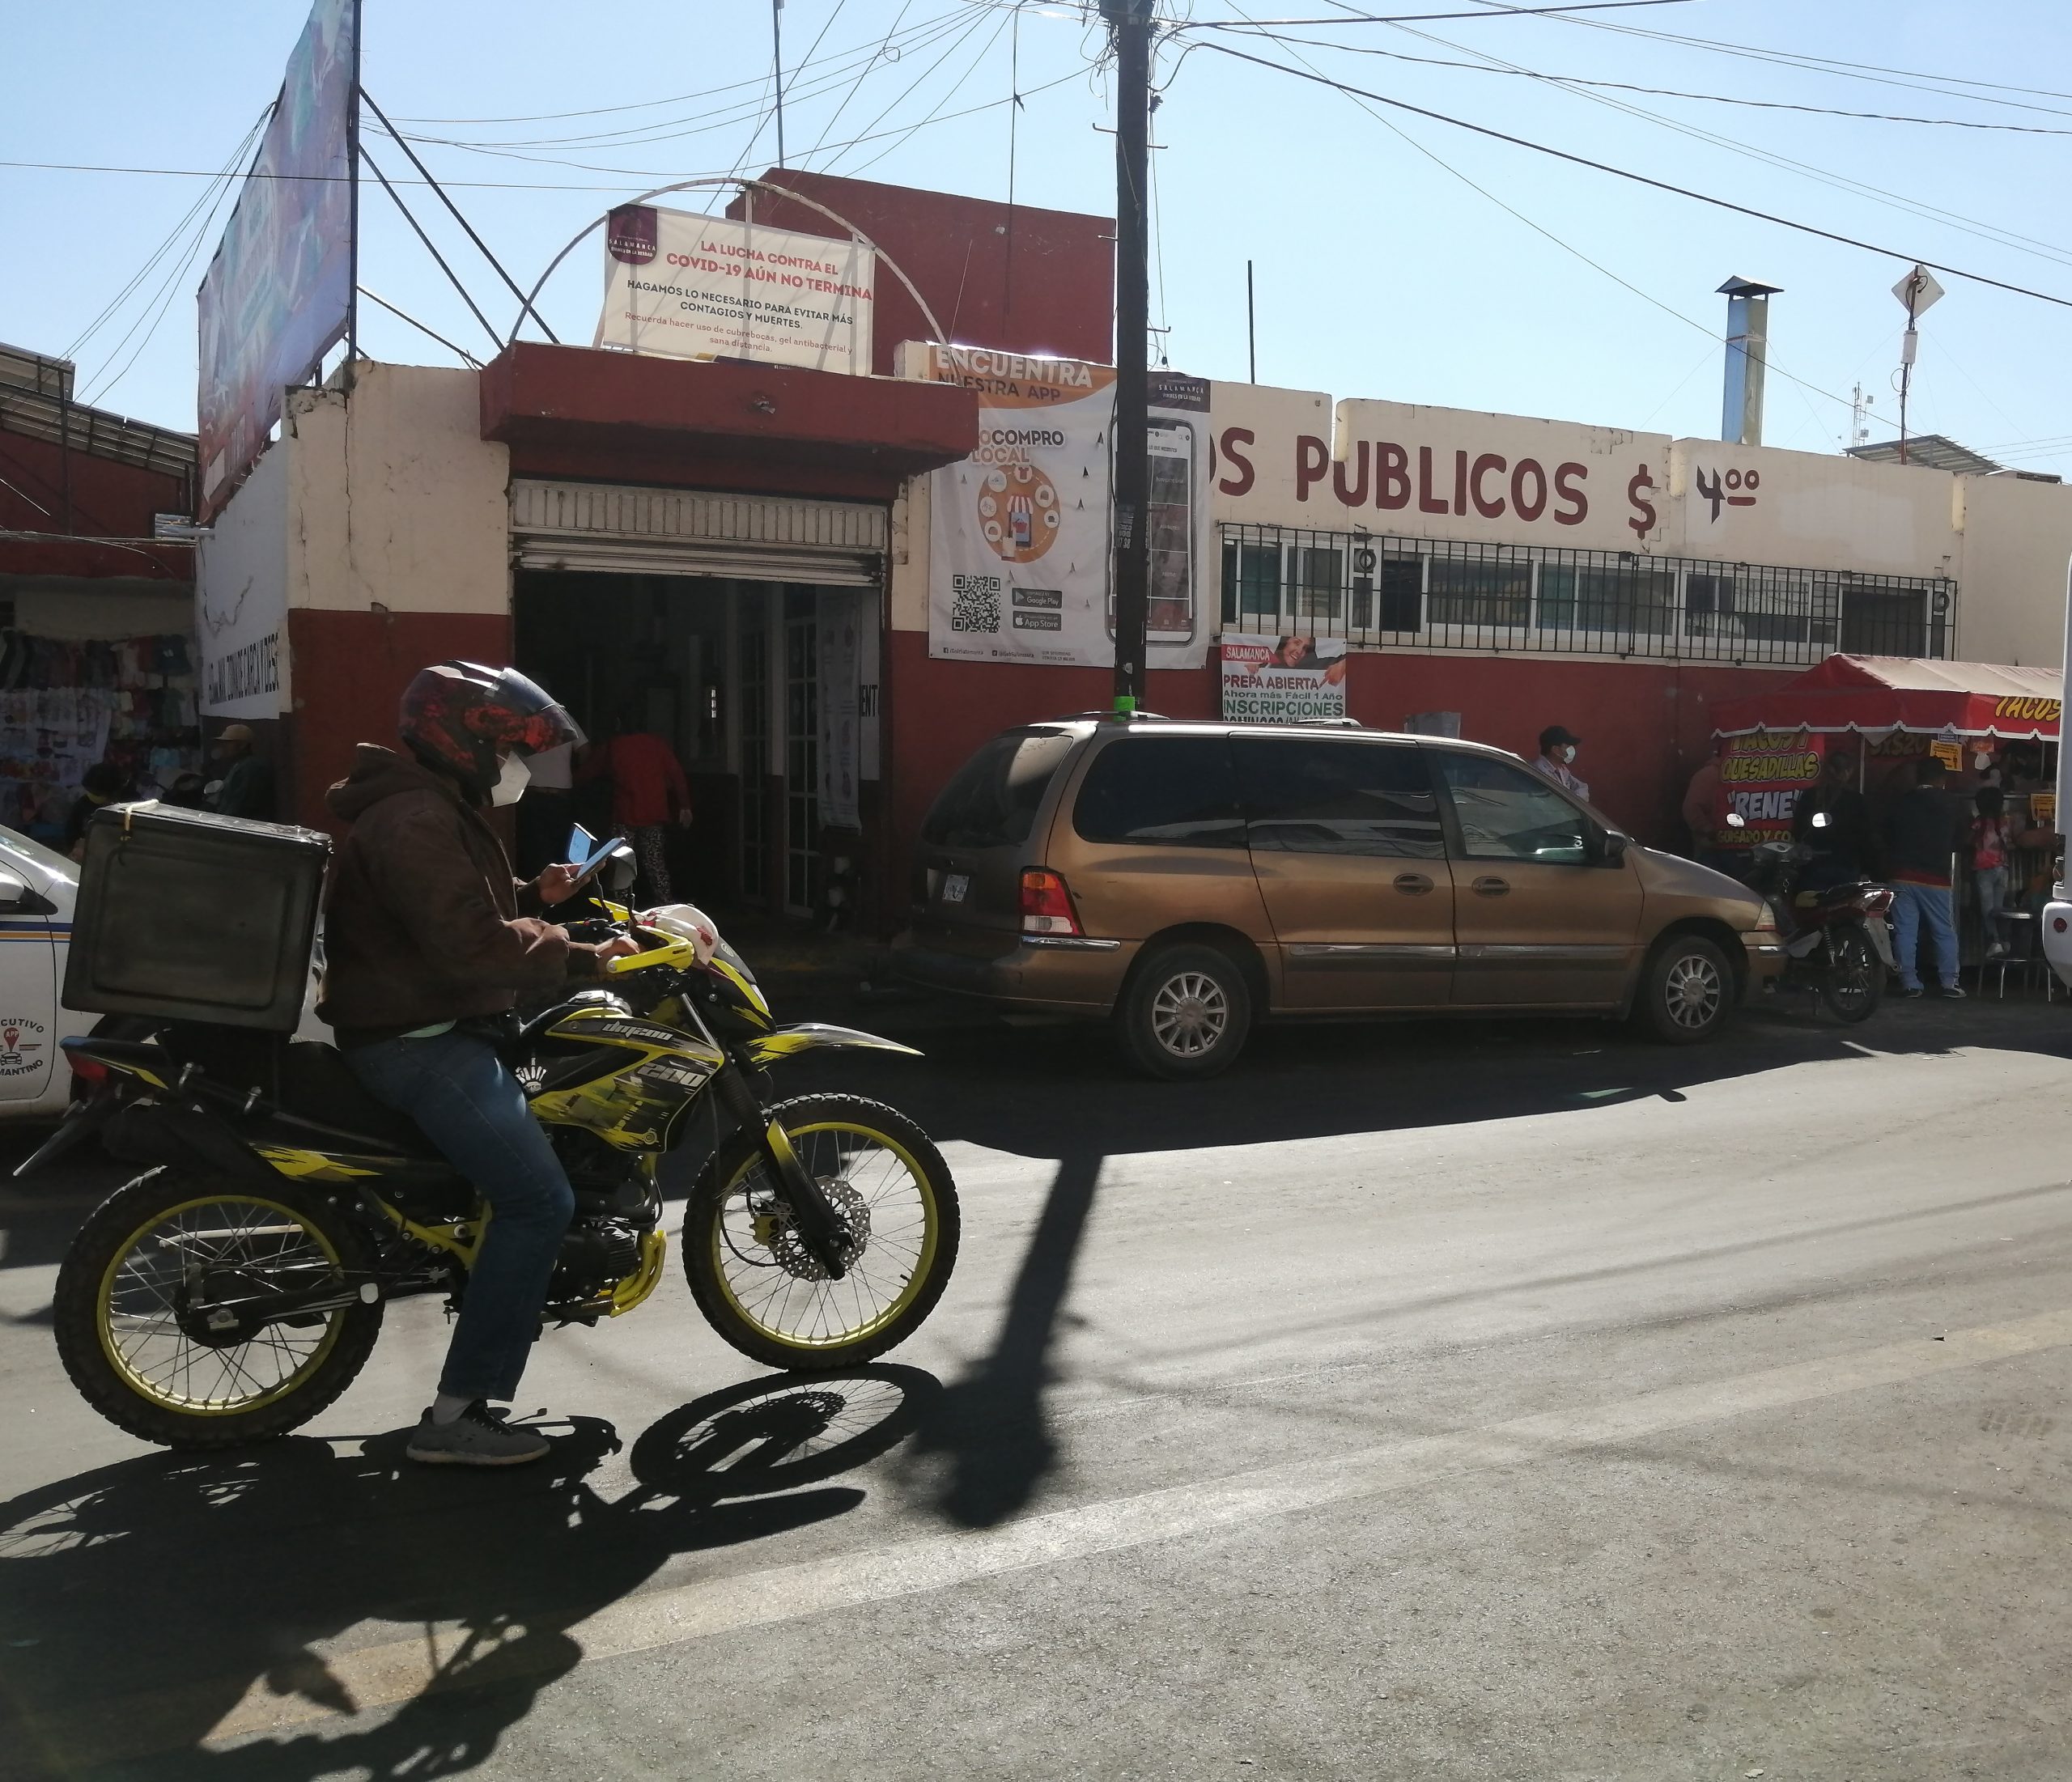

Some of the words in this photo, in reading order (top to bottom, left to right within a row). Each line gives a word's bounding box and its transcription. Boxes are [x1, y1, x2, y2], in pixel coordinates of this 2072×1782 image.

[701, 240, 717, 253] LA
[720, 244, 765, 262] LUCHA
[767, 253, 822, 273] CONTRA
[825, 263, 839, 275] EL
[666, 252, 741, 277] COVID-19
[744, 266, 777, 283] AÚN
[780, 274, 804, 288] NO
[806, 278, 873, 301] TERMINA
[627, 280, 682, 295] HAGAMOS
[686, 289, 698, 299] LO
[702, 291, 762, 309] NECESARIO
[765, 302, 792, 315] PARA
[794, 308, 830, 321] EVITAR
[832, 313, 853, 325] MÁS
[681, 301, 745, 319] CONTAGIOS
[746, 312, 752, 320] Y
[755, 314, 803, 329] MUERTES.
[625, 312, 667, 325] Recuerda
[669, 318, 694, 329] hacer
[696, 324, 711, 332] uso
[714, 325, 724, 333] de
[726, 329, 777, 343] cubrebocas,
[779, 336, 792, 346] gel
[794, 339, 846, 353] antibacterial
[709, 337, 729, 346] sana
[732, 340, 772, 352] distancia.
[936, 344, 1093, 388] ENCUENTRA
[1028, 385, 1060, 401] APP
[972, 448, 1030, 463] LOCAL
[1297, 435, 1589, 526] PUBLICOS
[1026, 596, 1047, 605] Google
[1047, 597, 1059, 606] Play
[1024, 618, 1039, 628] App
[1040, 619, 1059, 628] Store
[1226, 647, 1270, 660] SALAMANCA
[1224, 674, 1264, 688] PREPA
[1266, 676, 1319, 690] ABIERTA
[1224, 689, 1256, 698] Ahora
[1260, 691, 1282, 699] más
[1285, 691, 1310, 700] Fácil
[1322, 692, 1343, 701] Año
[1224, 699, 1344, 716] INSCRIPCIONES
[1996, 697, 2060, 721] TACOS
[1722, 751, 1821, 783] QUESADILLAS
[637, 1062, 708, 1088] 200
